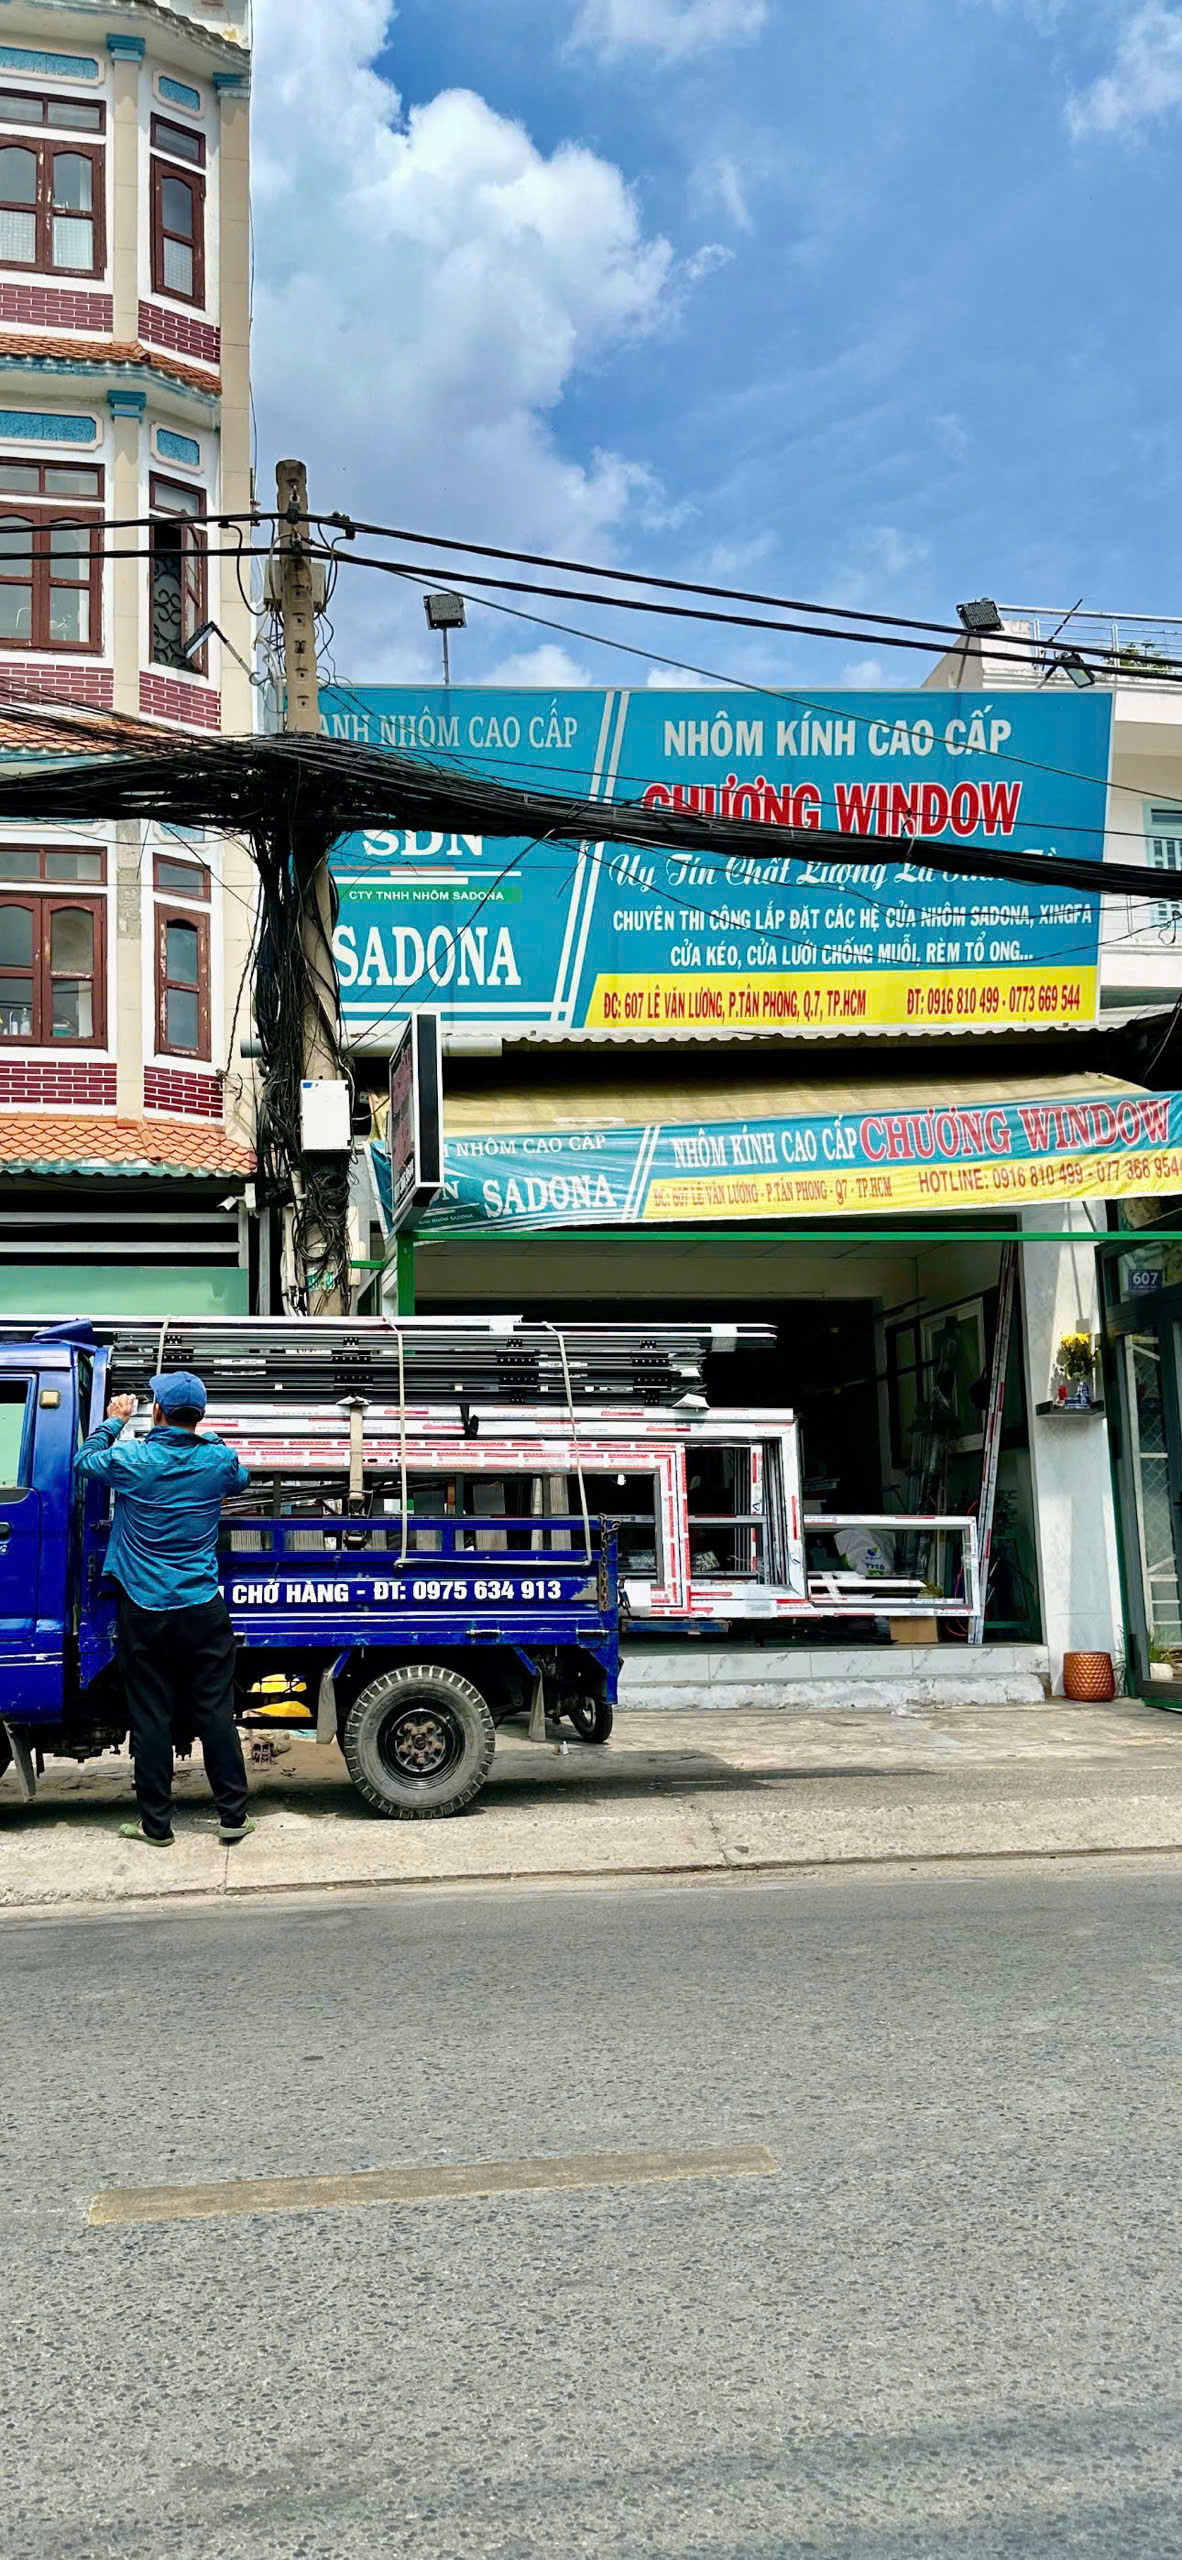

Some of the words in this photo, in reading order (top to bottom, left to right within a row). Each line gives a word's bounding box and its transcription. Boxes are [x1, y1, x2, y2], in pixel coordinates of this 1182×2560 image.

[380, 705, 461, 748] NHÔM
[468, 715, 521, 748] CAO
[528, 698, 578, 748] CẤP
[664, 710, 763, 758] NHÔM
[776, 711, 856, 756] KÍNH
[868, 719, 934, 756] CAO
[944, 704, 1012, 756] CẤP
[834, 781, 1023, 838] WINDOW
[609, 853, 656, 892] Uy
[666, 853, 718, 886] Tín
[725, 856, 791, 886] Chất
[348, 890, 373, 900] CTY
[376, 890, 409, 900] TNHH
[413, 888, 449, 901] NHÔM
[453, 890, 504, 901] SADONA
[613, 905, 674, 931] CHUYÊN
[679, 910, 705, 931] THI
[709, 904, 751, 930] CÔNG
[756, 901, 785, 930] LẮP
[789, 905, 820, 935] ĐẶT
[825, 903, 855, 929] CÁC
[860, 903, 880, 932] HỆ
[885, 900, 916, 928] CỬA
[921, 901, 966, 927] NHÔM
[970, 904, 1034, 928] SADONA,
[1038, 903, 1092, 925] XINGFA
[332, 926, 521, 987] SADONA
[670, 938, 701, 967] CỬA
[706, 940, 742, 970] KÉO,
[746, 937, 776, 966] CỬA
[782, 939, 817, 966] LƯỚI
[821, 936, 873, 965] CHỐNG
[926, 939, 960, 962] RÈM
[965, 931, 985, 962] TỔ
[990, 941, 1034, 962] ONG...
[604, 991, 621, 1019] ĐC:
[624, 992, 644, 1019] 607
[648, 984, 661, 1019] LÊ
[665, 987, 685, 1018] VĂN
[688, 986, 725, 1024] LƯƠNG,
[728, 984, 759, 1018] P.TÂN
[763, 990, 800, 1022] PHONG,
[803, 990, 823, 1023] Q.7,
[827, 989, 866, 1017] TP.HCM
[907, 988, 924, 1016] ĐT:
[927, 988, 954, 1015] 0916
[956, 987, 977, 1014] 810
[979, 986, 1000, 1013] 499
[1009, 986, 1035, 1013] 0773
[1038, 985, 1058, 1012] 669
[1061, 984, 1081, 1011] 544
[455, 1137, 516, 1157] NHÔM
[522, 1138, 563, 1154] CAO
[672, 1128, 728, 1168] NHÔM
[729, 1125, 778, 1166] KÍNH
[781, 1129, 818, 1162] CAO
[822, 1114, 858, 1161] CẤP
[859, 1105, 1012, 1162] CHƯƠNG
[1017, 1097, 1172, 1152] WINDOW
[705, 1181, 725, 1206] VĂN
[729, 1181, 759, 1205] LƯƠNG
[767, 1177, 793, 1202] P.TÂN
[796, 1179, 828, 1201] PHONG
[856, 1177, 893, 1199] TP.HCM
[918, 1168, 989, 1193] HOTLINE:
[992, 1166, 1025, 1189] 0916
[1030, 1164, 1054, 1186] 810
[1059, 1162, 1084, 1184] 499
[1096, 1159, 1120, 1183] 077
[1153, 1155, 1182, 1178] 954
[482, 1174, 618, 1219] SADONA
[1132, 1272, 1158, 1285] 607
[232, 1579, 280, 1604] CHỞ
[286, 1580, 349, 1604] HÀNG
[374, 1581, 406, 1600] ĐT:
[413, 1581, 468, 1600] 0975
[474, 1581, 515, 1600] 634
[521, 1580, 561, 1600] 913
